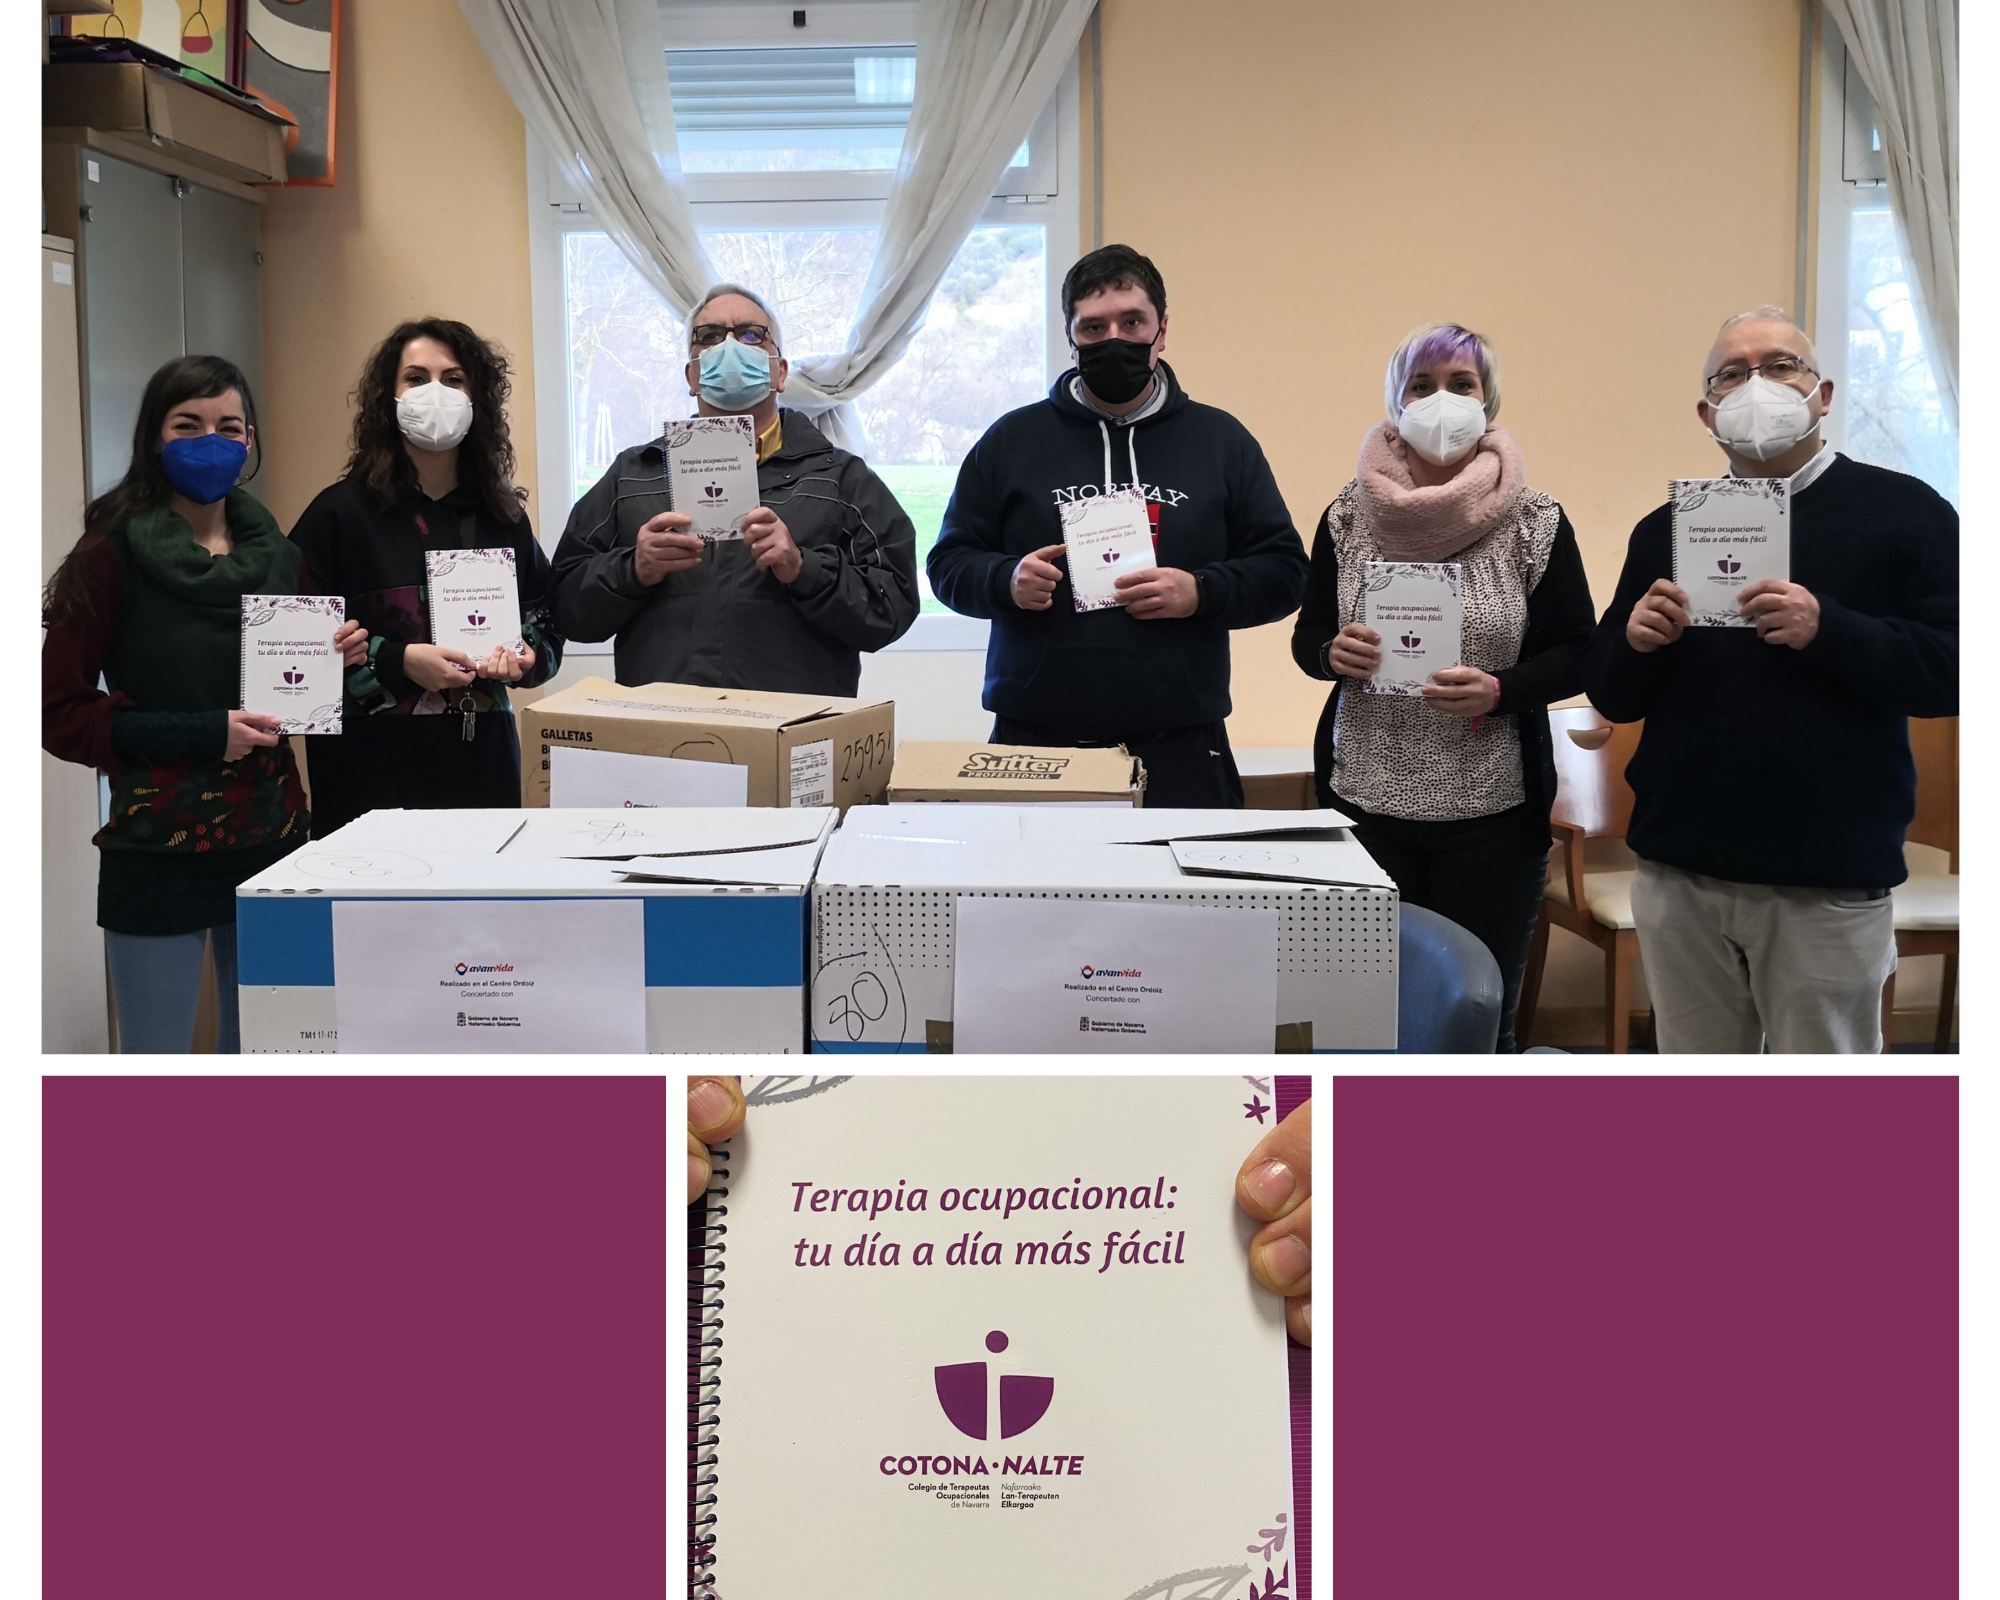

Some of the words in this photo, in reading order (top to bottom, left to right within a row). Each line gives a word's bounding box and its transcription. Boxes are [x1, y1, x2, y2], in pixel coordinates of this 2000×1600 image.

[541, 728, 593, 742] GALLETAS
[963, 752, 1070, 773] Sutter
[967, 771, 1051, 780] PROFESSIONAL
[469, 964, 514, 972] avanvida
[1096, 968, 1142, 978] avanvida
[1086, 995, 1126, 1003] Concertado
[791, 1178, 928, 1221] Terapia
[939, 1176, 1178, 1220] ocupacional:
[794, 1238, 832, 1267] tu
[844, 1230, 900, 1267] día
[912, 1242, 934, 1266] a
[945, 1230, 1002, 1266] día
[1014, 1230, 1092, 1266] más
[1098, 1230, 1186, 1274] fácil
[908, 1483, 937, 1492] Colegio
[950, 1483, 989, 1492] Terapeutas
[1001, 1483, 1041, 1492] Nafarroako
[936, 1492, 989, 1500] Ocupacionales
[1001, 1492, 1060, 1500] Lan-Terapeuten
[1001, 1501, 1034, 1509] Elkargoa
